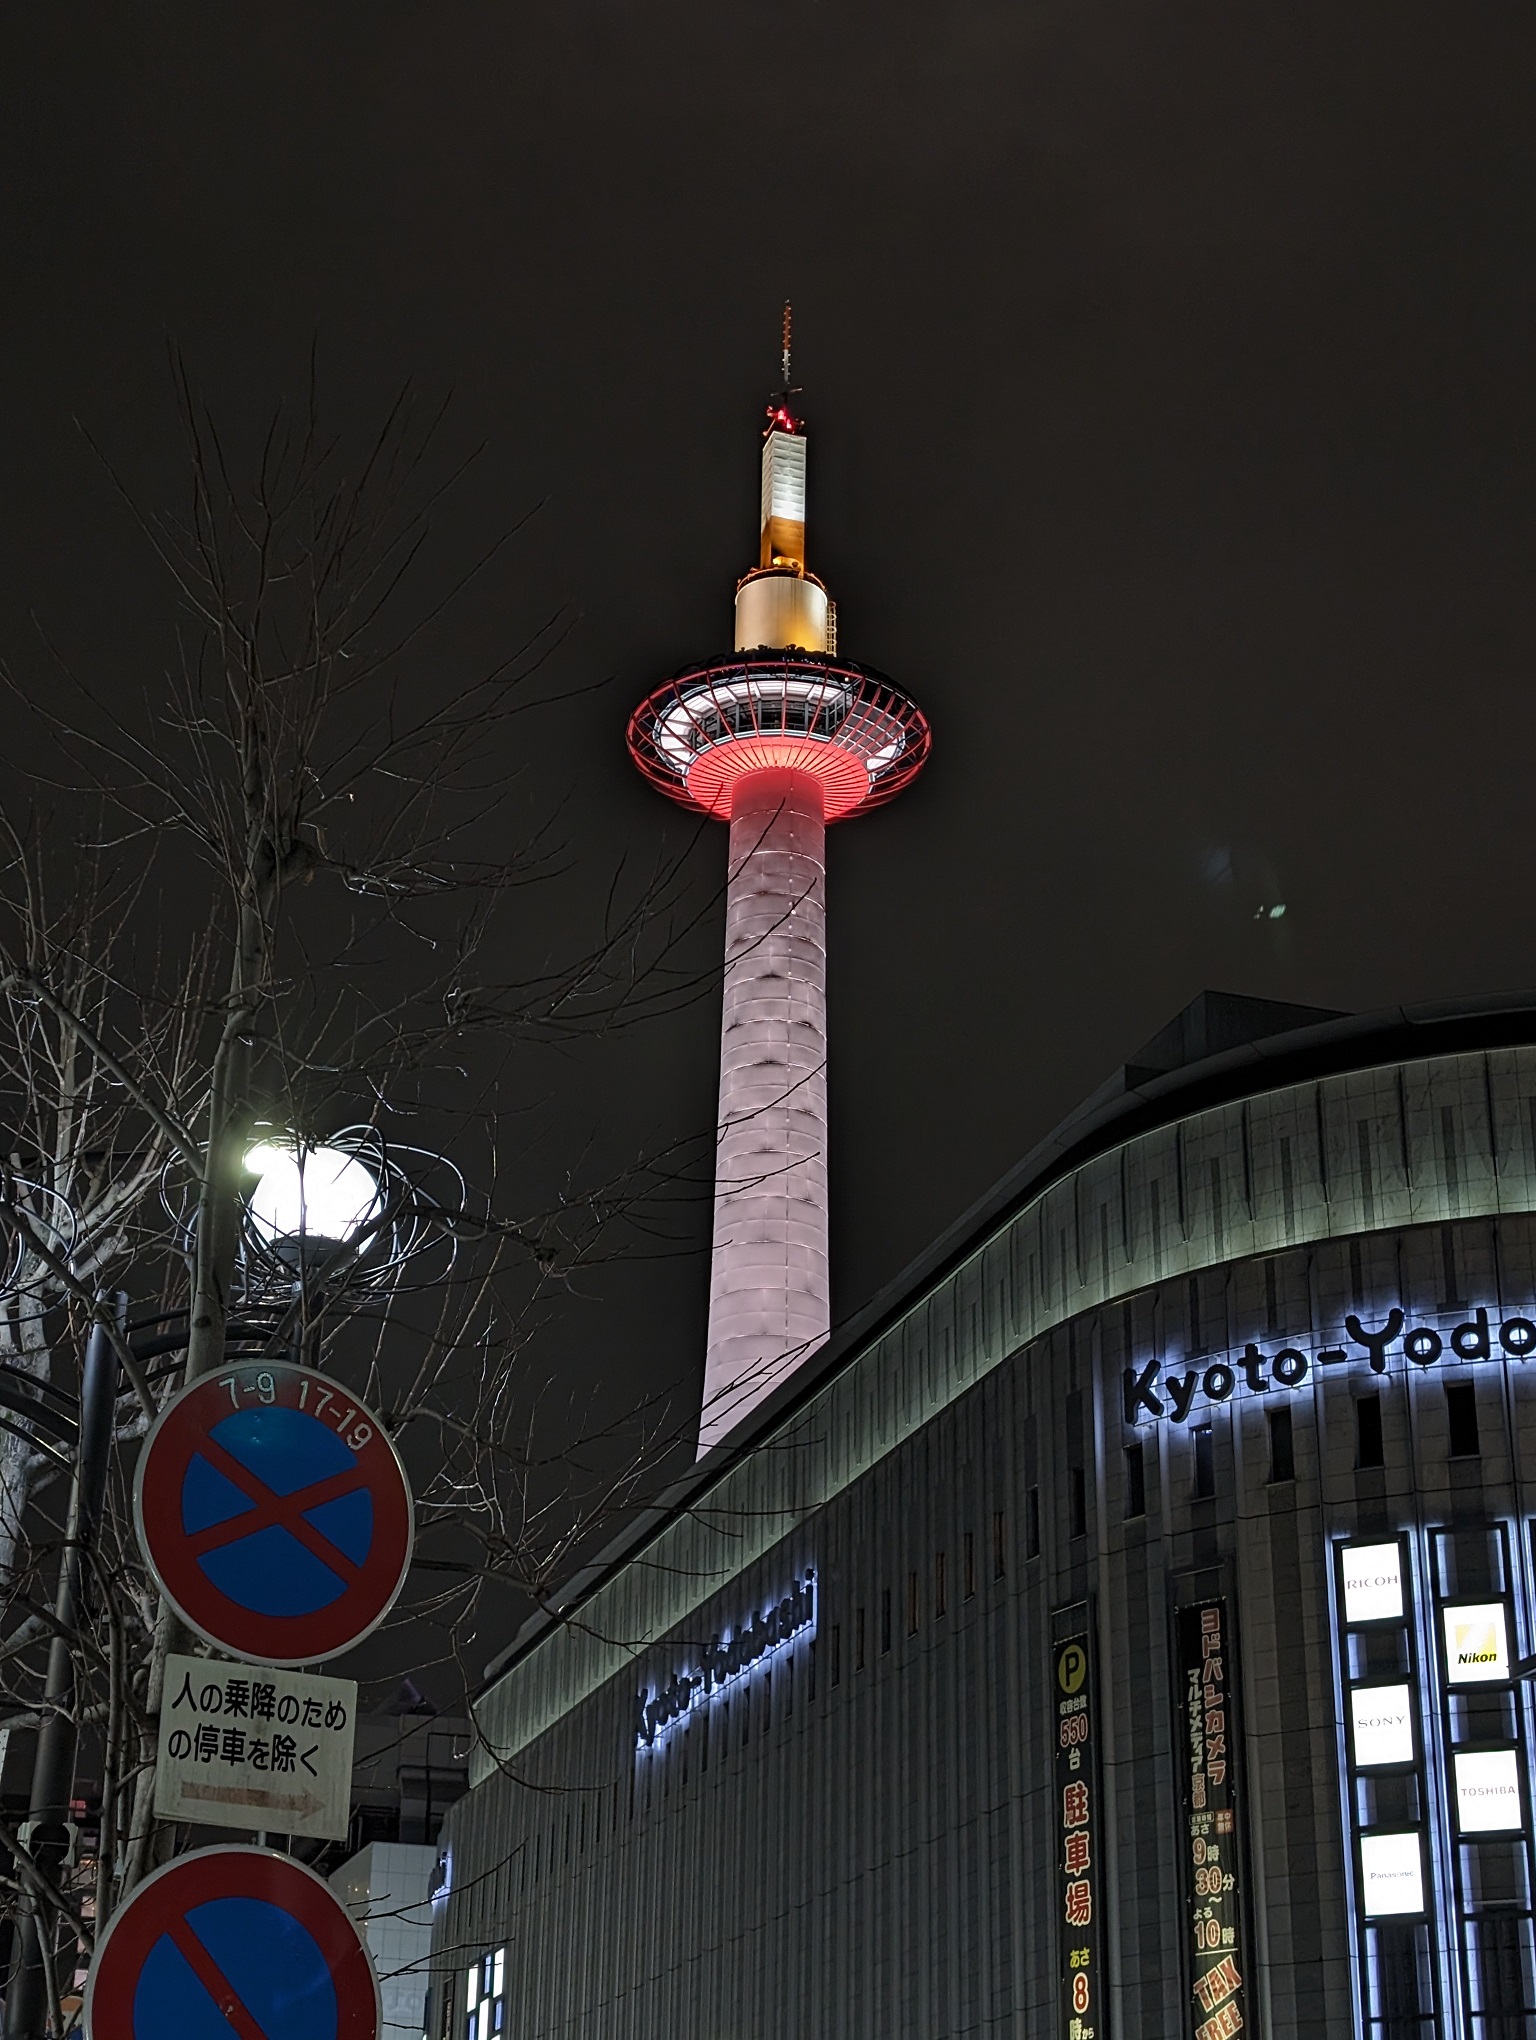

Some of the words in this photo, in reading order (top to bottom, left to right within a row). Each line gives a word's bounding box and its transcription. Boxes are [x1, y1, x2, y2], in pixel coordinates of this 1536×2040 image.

[1123, 1307, 1536, 1425] Kyoto-Yodo
[219, 1371, 276, 1409] 7-9
[299, 1380, 374, 1451] 17-19
[1346, 1574, 1399, 1590] RICOH
[1458, 1650, 1498, 1665] Nikon
[172, 1671, 347, 1731] 人の乗降のため
[1200, 1607, 1227, 1786] ヨドバシカメラ
[1060, 1713, 1088, 1748] 550
[1187, 1668, 1207, 1809] マルチメディア京都
[1357, 1714, 1406, 1730] SONY
[168, 1723, 320, 1777] の停車を除く
[1068, 1747, 1081, 1770] 台
[1461, 1785, 1516, 1797] TOSHIBA
[1190, 1823, 1210, 1837] あさ
[1063, 1779, 1092, 1927] 駐車場
[1195, 1865, 1235, 1896] 30分
[1193, 1907, 1213, 1920] よる
[1069, 1947, 1090, 1969] あさ
[1073, 1971, 1090, 2014] 8
[1193, 1953, 1242, 2013] TAX
